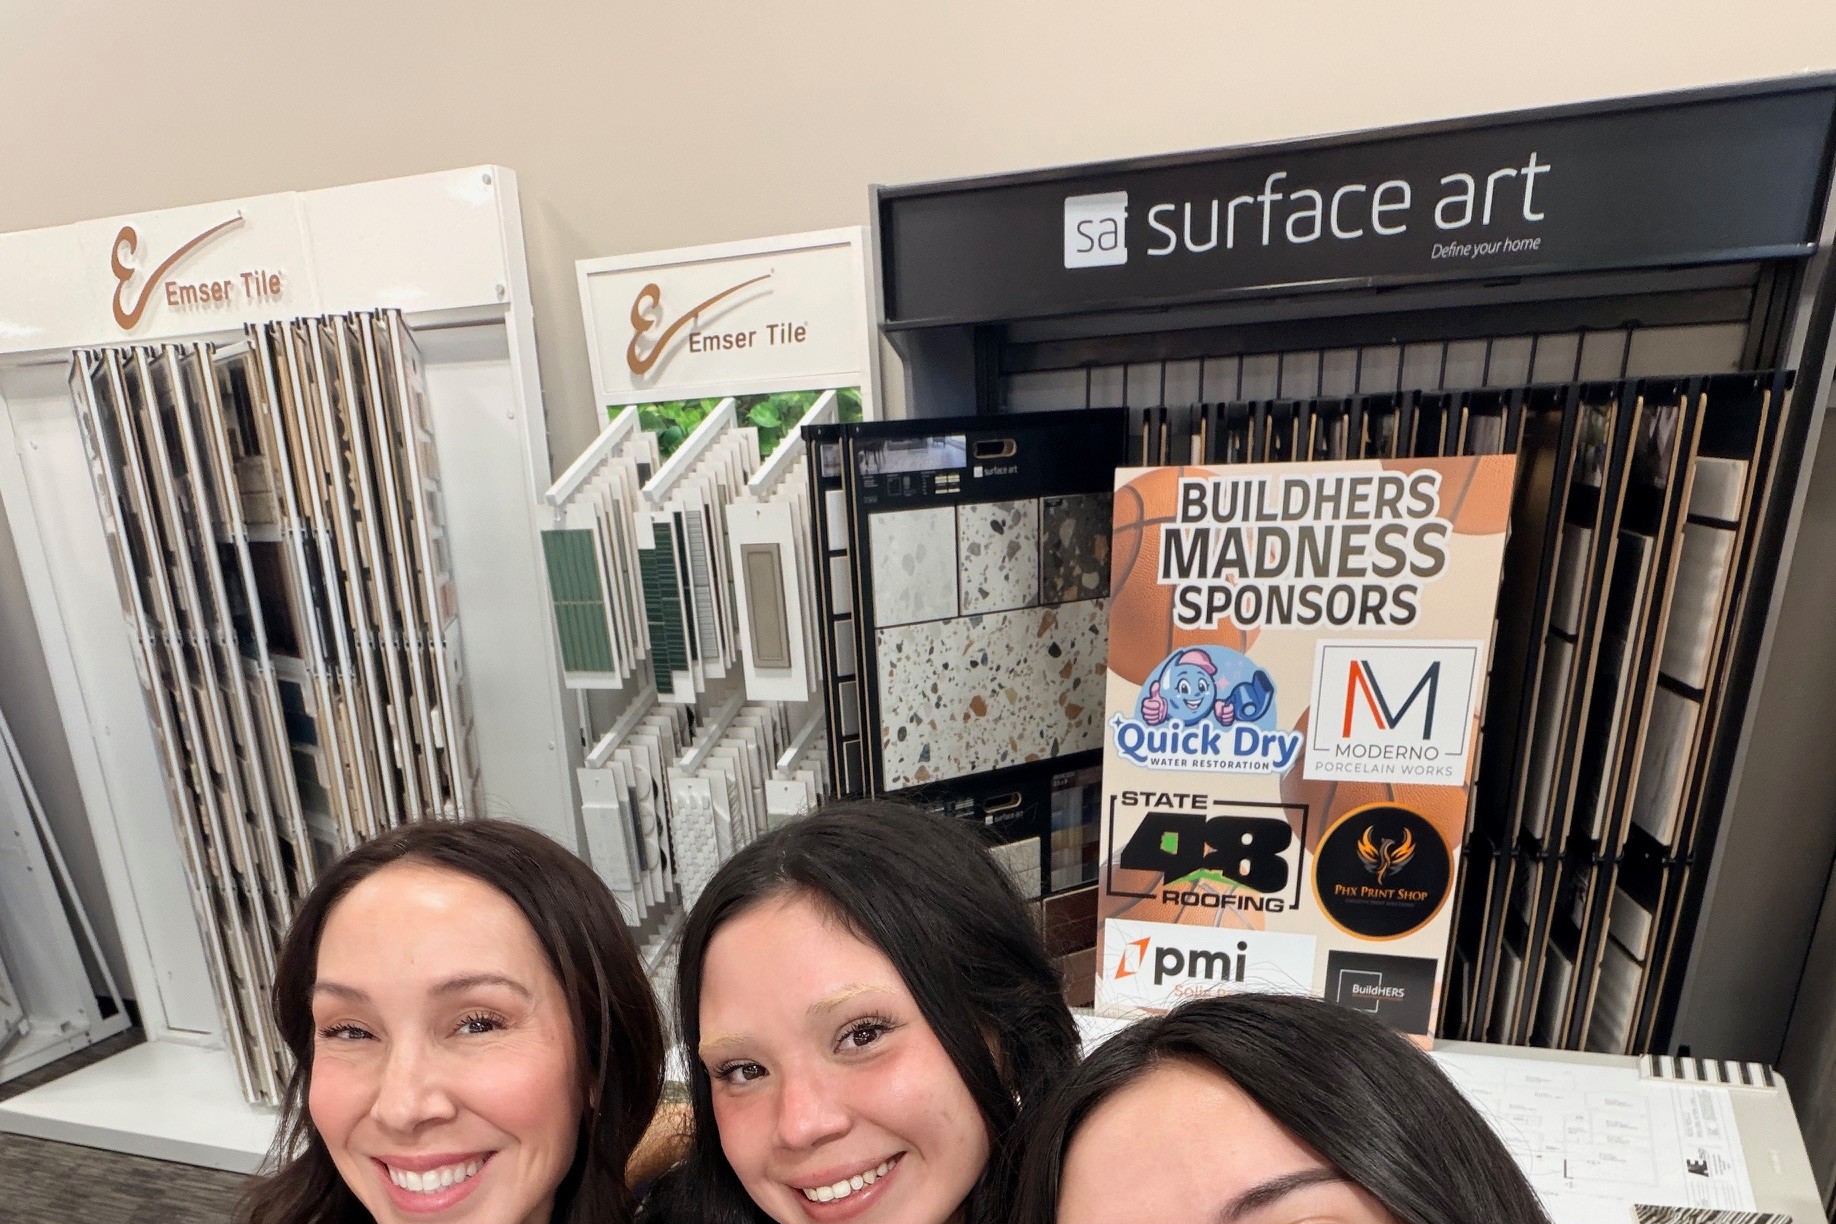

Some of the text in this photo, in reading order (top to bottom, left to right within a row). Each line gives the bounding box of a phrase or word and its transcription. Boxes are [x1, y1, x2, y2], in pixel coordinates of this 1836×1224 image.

[1076, 150, 1551, 257] sa surface art
[1430, 236, 1541, 259] Define your home
[164, 270, 281, 306] Emser Tile
[688, 322, 807, 353] Emser Tile
[1180, 473, 1437, 524] BUILDHERS
[1161, 522, 1449, 580] MADNESS
[1177, 583, 1419, 626] SPONSORS
[1117, 722, 1300, 768] Quick Dry
[1335, 743, 1439, 761] MODERNO
[1150, 757, 1270, 770] WATER RESTORATION
[1315, 761, 1453, 777] PORCELAIN WORKS
[1121, 790, 1209, 810] STATE
[1119, 811, 1293, 894] 48
[1162, 890, 1285, 913] ROOFING
[1153, 940, 1248, 986] pmi
[1352, 983, 1405, 998] BuildHERS
